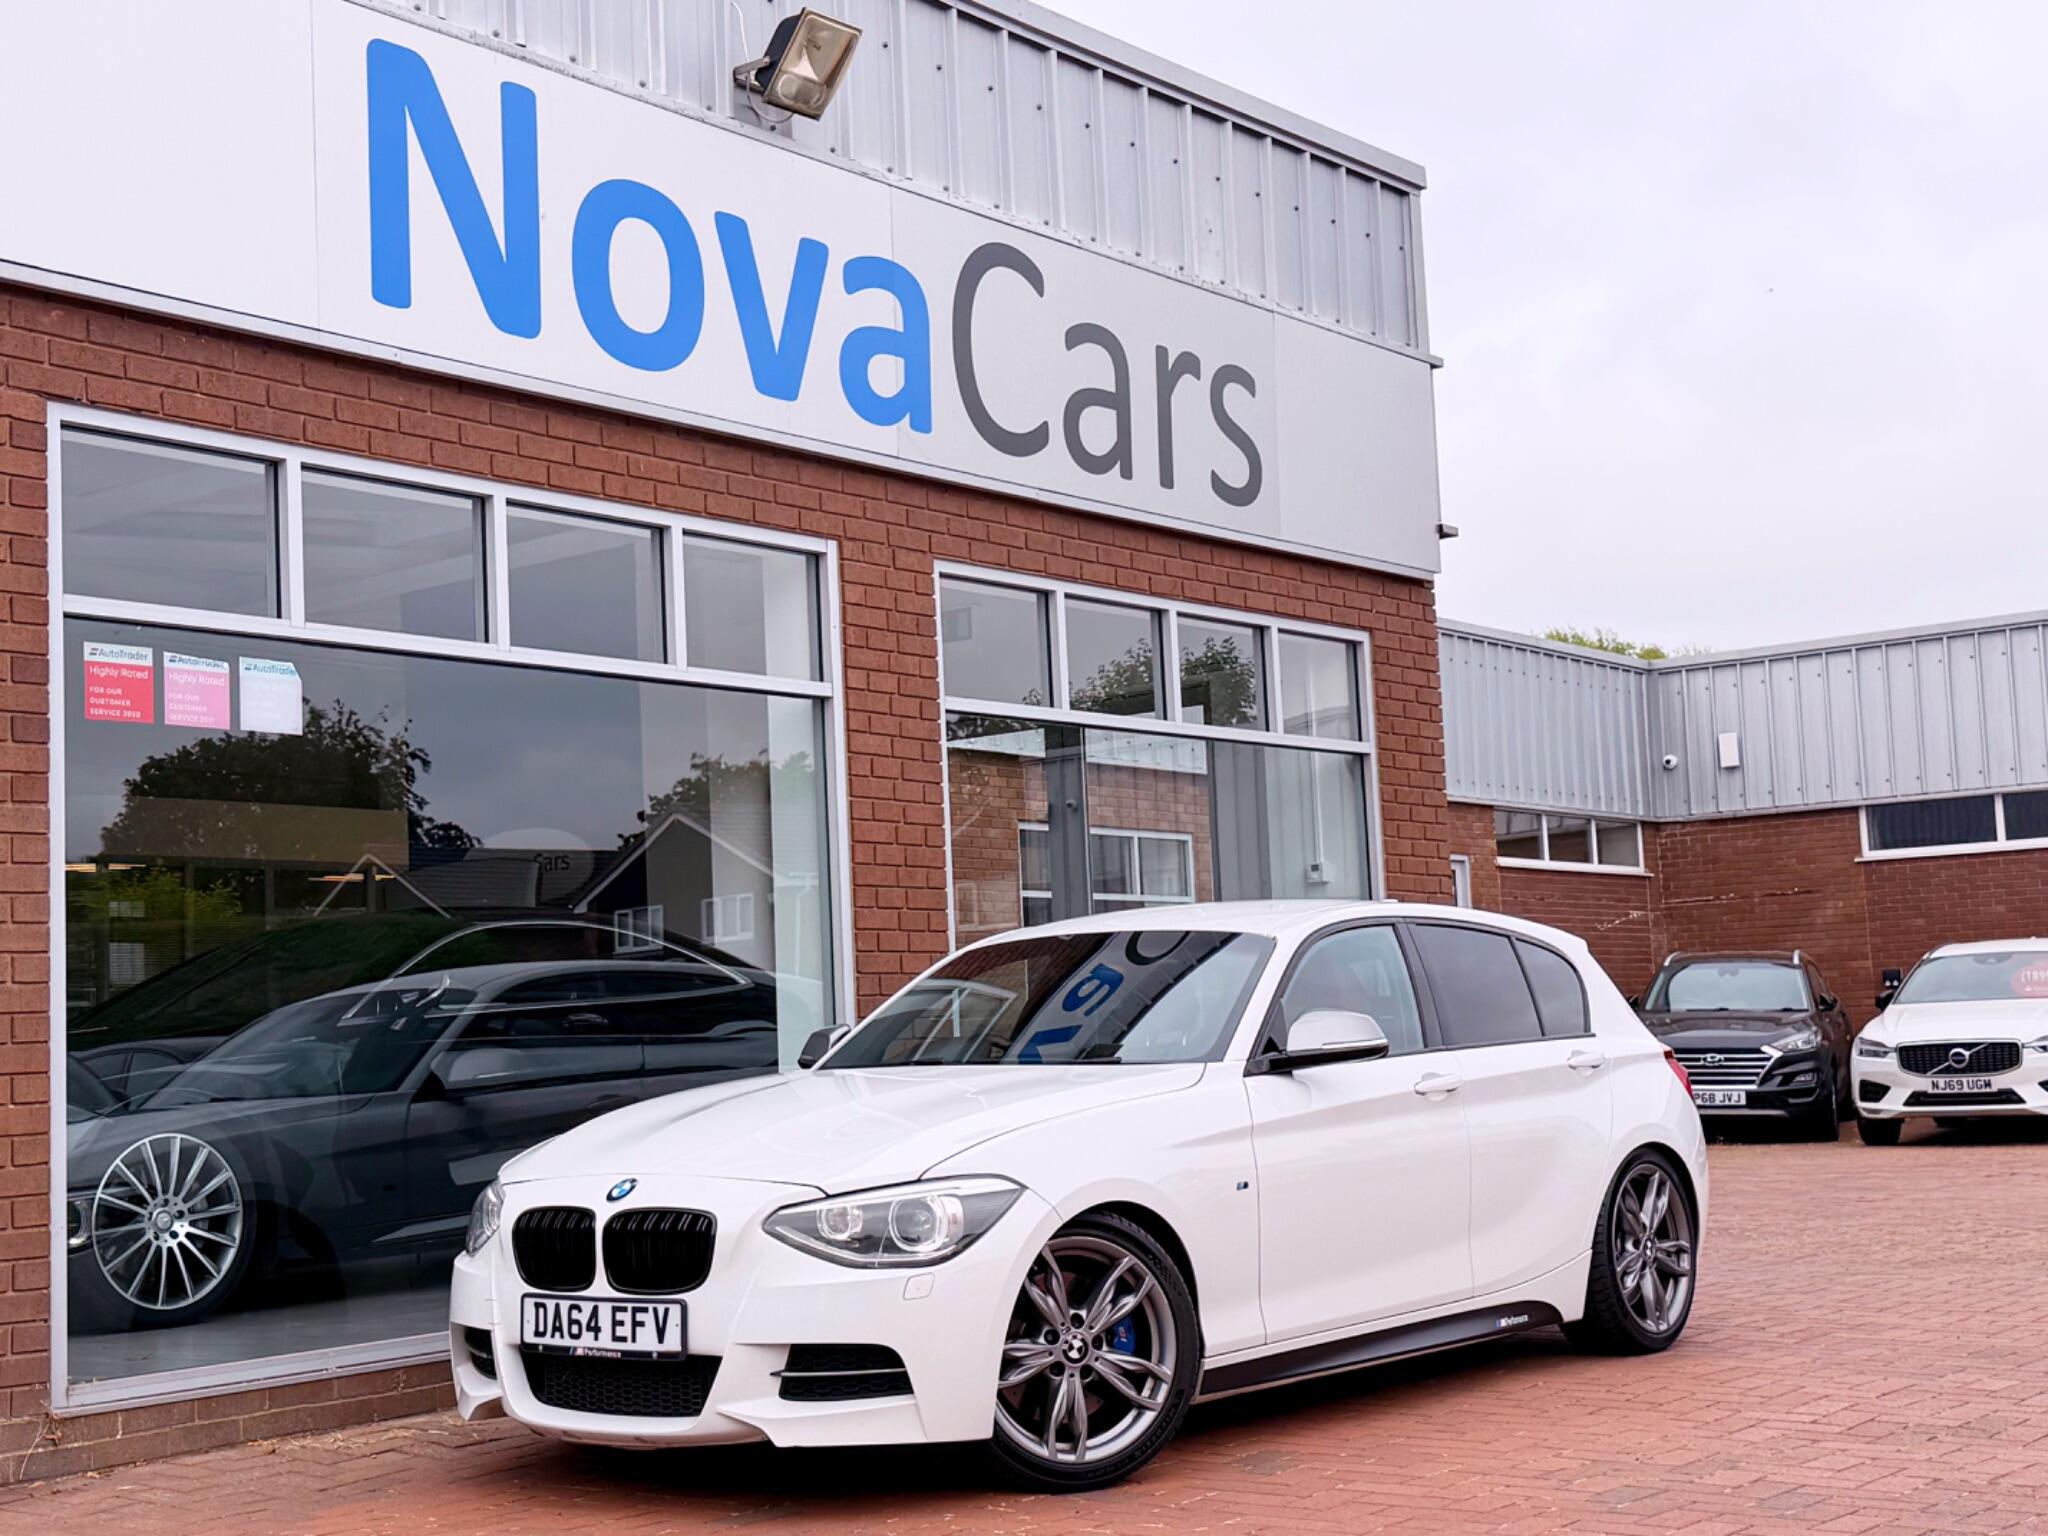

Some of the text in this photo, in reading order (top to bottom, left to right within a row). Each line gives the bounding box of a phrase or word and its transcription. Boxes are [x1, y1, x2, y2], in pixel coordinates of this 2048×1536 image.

[98, 647, 149, 661] AutoTrader
[90, 665, 149, 680] Highly Rated
[168, 672, 225, 687] Highly Rated
[89, 686, 123, 696] FOR OUR
[89, 697, 132, 708] CUSTOMER
[89, 708, 120, 718] SERVICE
[1931, 1078, 1992, 1091] NJ69 UGM
[1719, 1092, 1741, 1104] JVJ
[533, 1301, 671, 1345] DA64 EFV
